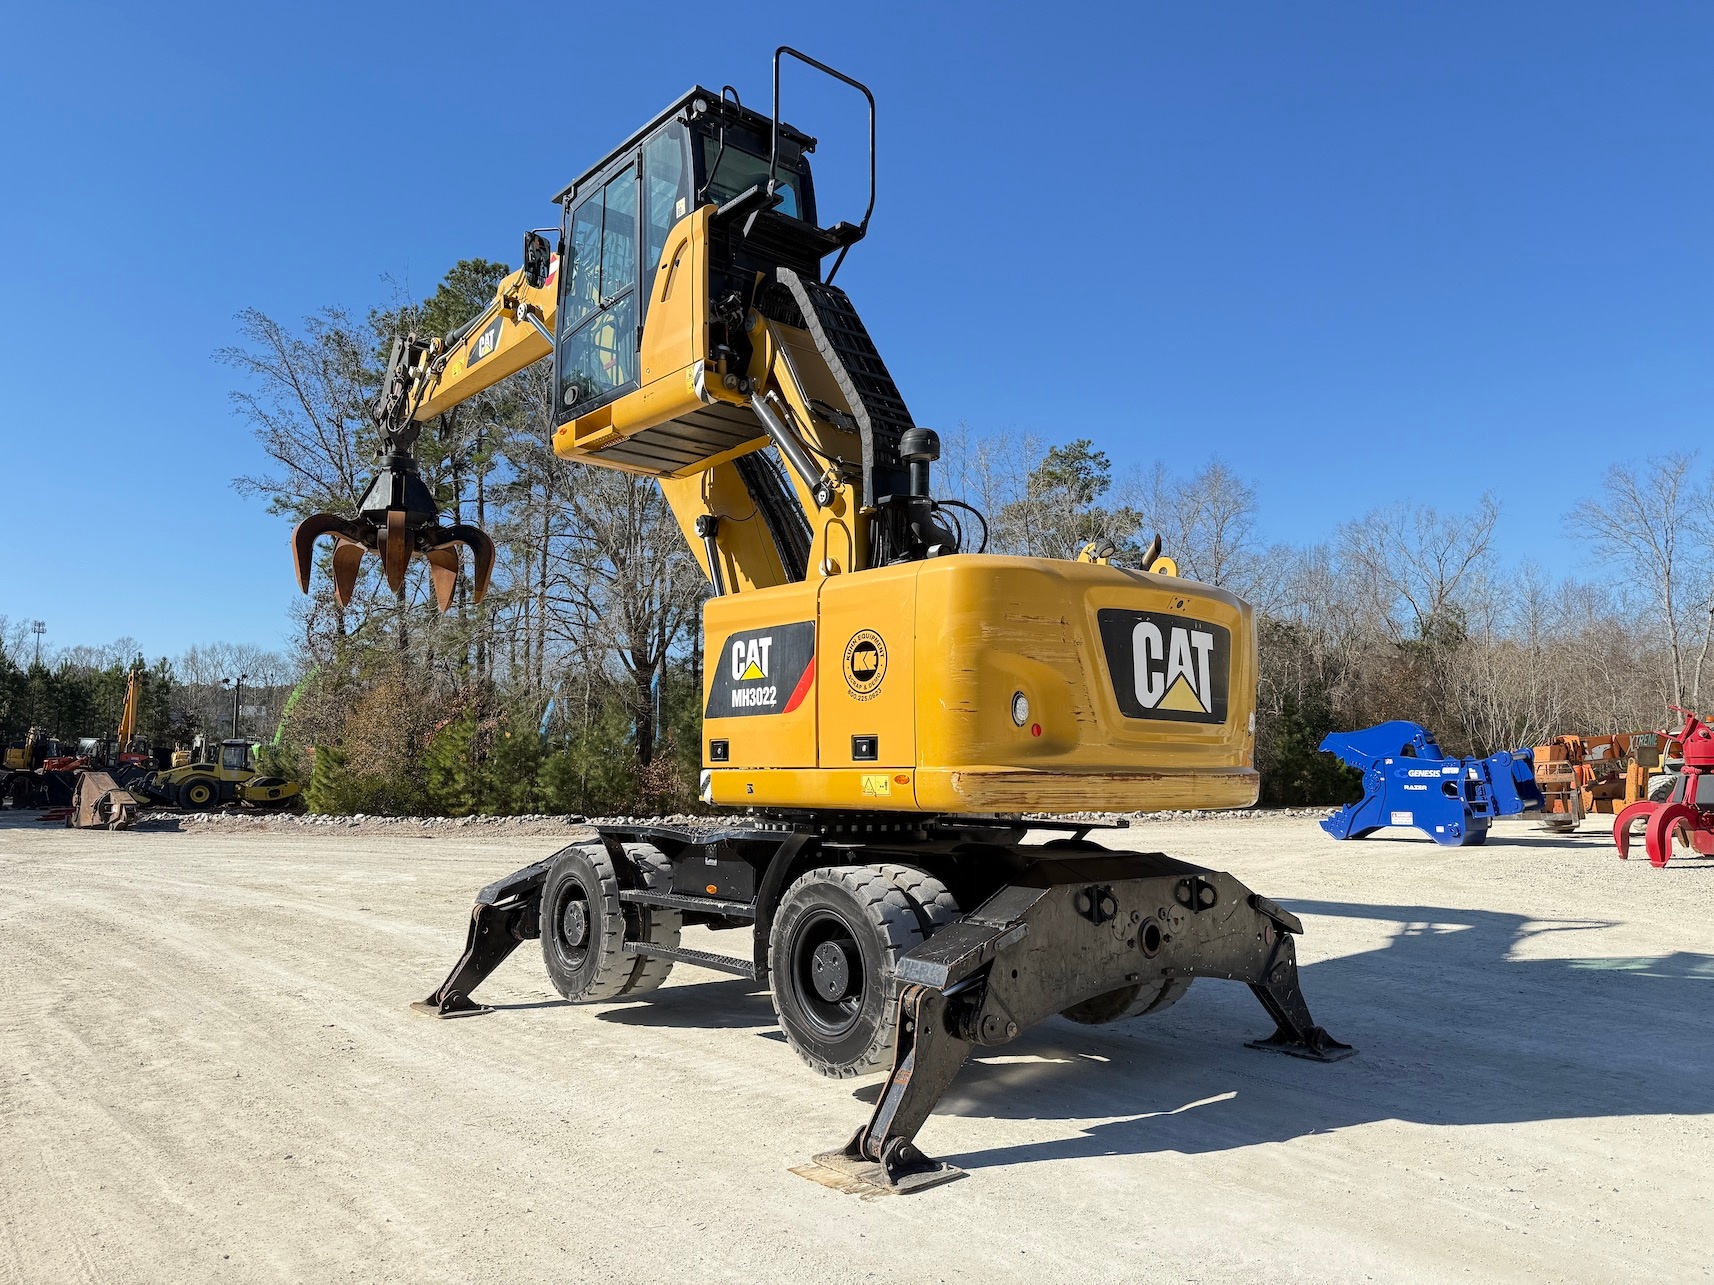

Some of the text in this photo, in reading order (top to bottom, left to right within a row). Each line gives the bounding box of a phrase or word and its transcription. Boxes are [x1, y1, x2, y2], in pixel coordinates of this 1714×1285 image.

[479, 328, 495, 358] CAT
[731, 636, 773, 681] CAT
[846, 632, 885, 661] KUHN EQUIPMENT
[1132, 621, 1214, 714] CAT
[847, 674, 863, 690] SCRAP
[868, 672, 882, 688] DEMO
[731, 685, 778, 708] MH3022
[1626, 733, 1658, 755] XTREME
[1407, 769, 1441, 778] GENESIS
